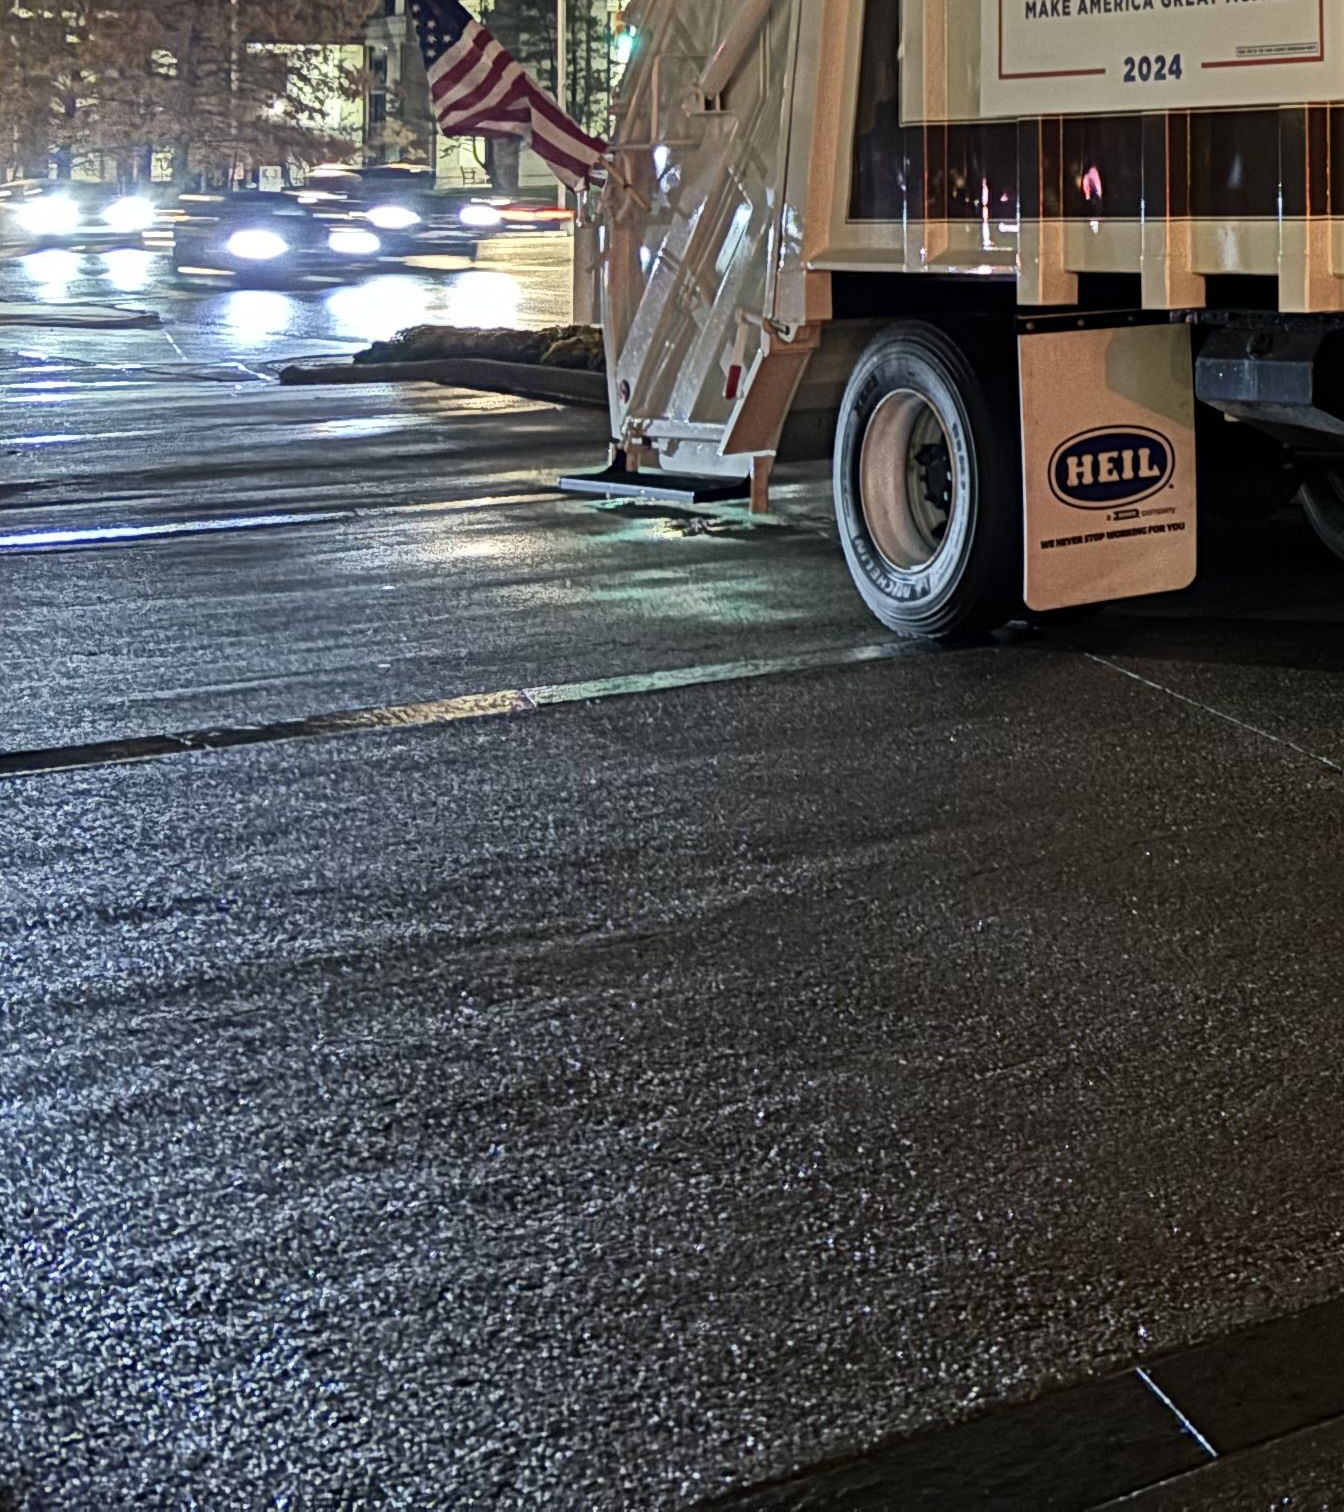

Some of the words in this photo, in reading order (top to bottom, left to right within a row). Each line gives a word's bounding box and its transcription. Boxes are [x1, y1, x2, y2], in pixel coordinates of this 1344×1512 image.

[1123, 53, 1183, 82] 2024
[1066, 447, 1161, 487] HEIL
[1040, 540, 1055, 550] WE
[1055, 535, 1083, 547] NEVER
[1084, 532, 1106, 543] STOP
[1106, 527, 1147, 539] WORKING
[1148, 523, 1166, 534] FOR
[1166, 521, 1186, 531] YOU
[854, 537, 912, 599] MICHELIN
